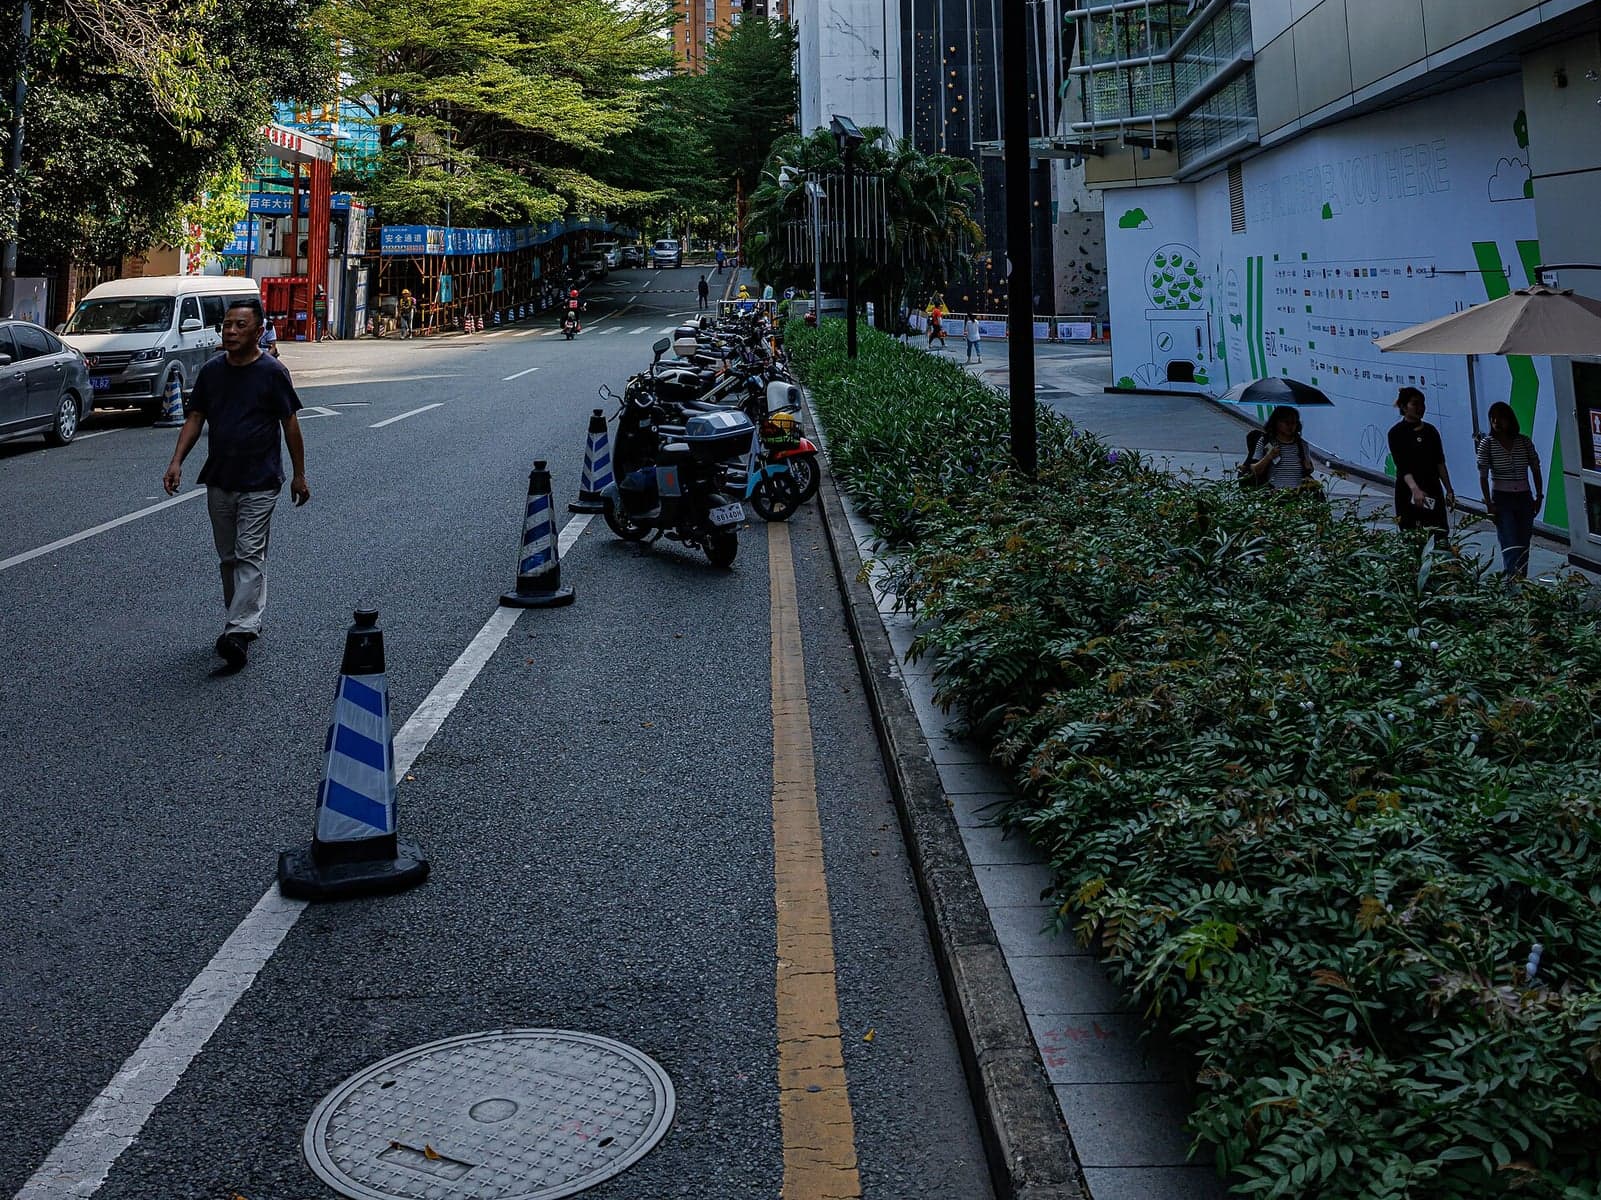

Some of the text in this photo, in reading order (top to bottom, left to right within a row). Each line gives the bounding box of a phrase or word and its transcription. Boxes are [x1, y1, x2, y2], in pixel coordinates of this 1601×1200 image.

[1337, 154, 1379, 206] YOU
[1383, 137, 1450, 200] HERE
[250, 198, 293, 208] 百年大计
[384, 233, 422, 243] 安全通道
